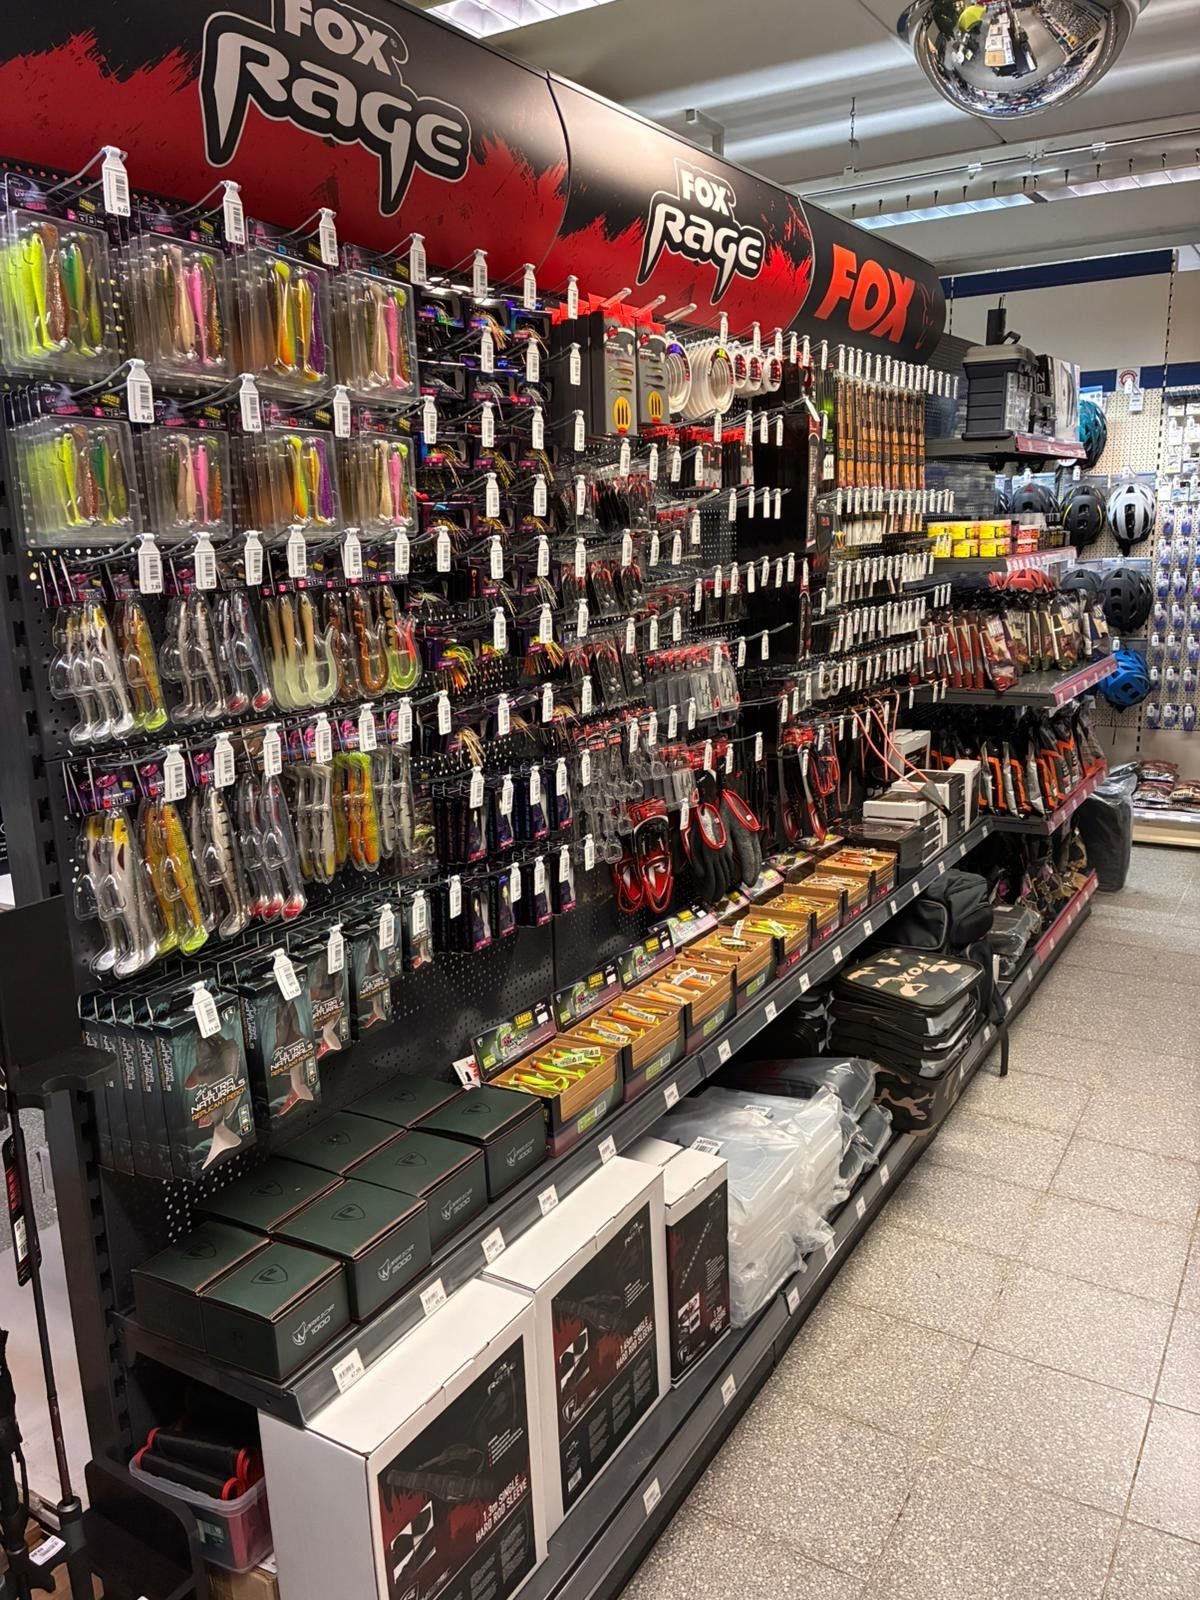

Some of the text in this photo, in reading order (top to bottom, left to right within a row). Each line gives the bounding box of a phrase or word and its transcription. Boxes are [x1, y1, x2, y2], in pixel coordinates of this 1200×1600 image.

[284, 0, 392, 76] FOX
[681, 170, 730, 217] FOX
[813, 243, 917, 344] FOX
[191, 1077, 246, 1114] NATURALS
[201, 1077, 235, 1100] ULTRA
[310, 1314, 331, 1336] 1000
[475, 1517, 493, 1544] HARD
[493, 1502, 506, 1524] ROD
[506, 1477, 528, 1509] SLEEVE
[483, 1501, 498, 1522] 1.3m
[498, 1474, 519, 1505] SINGLE
